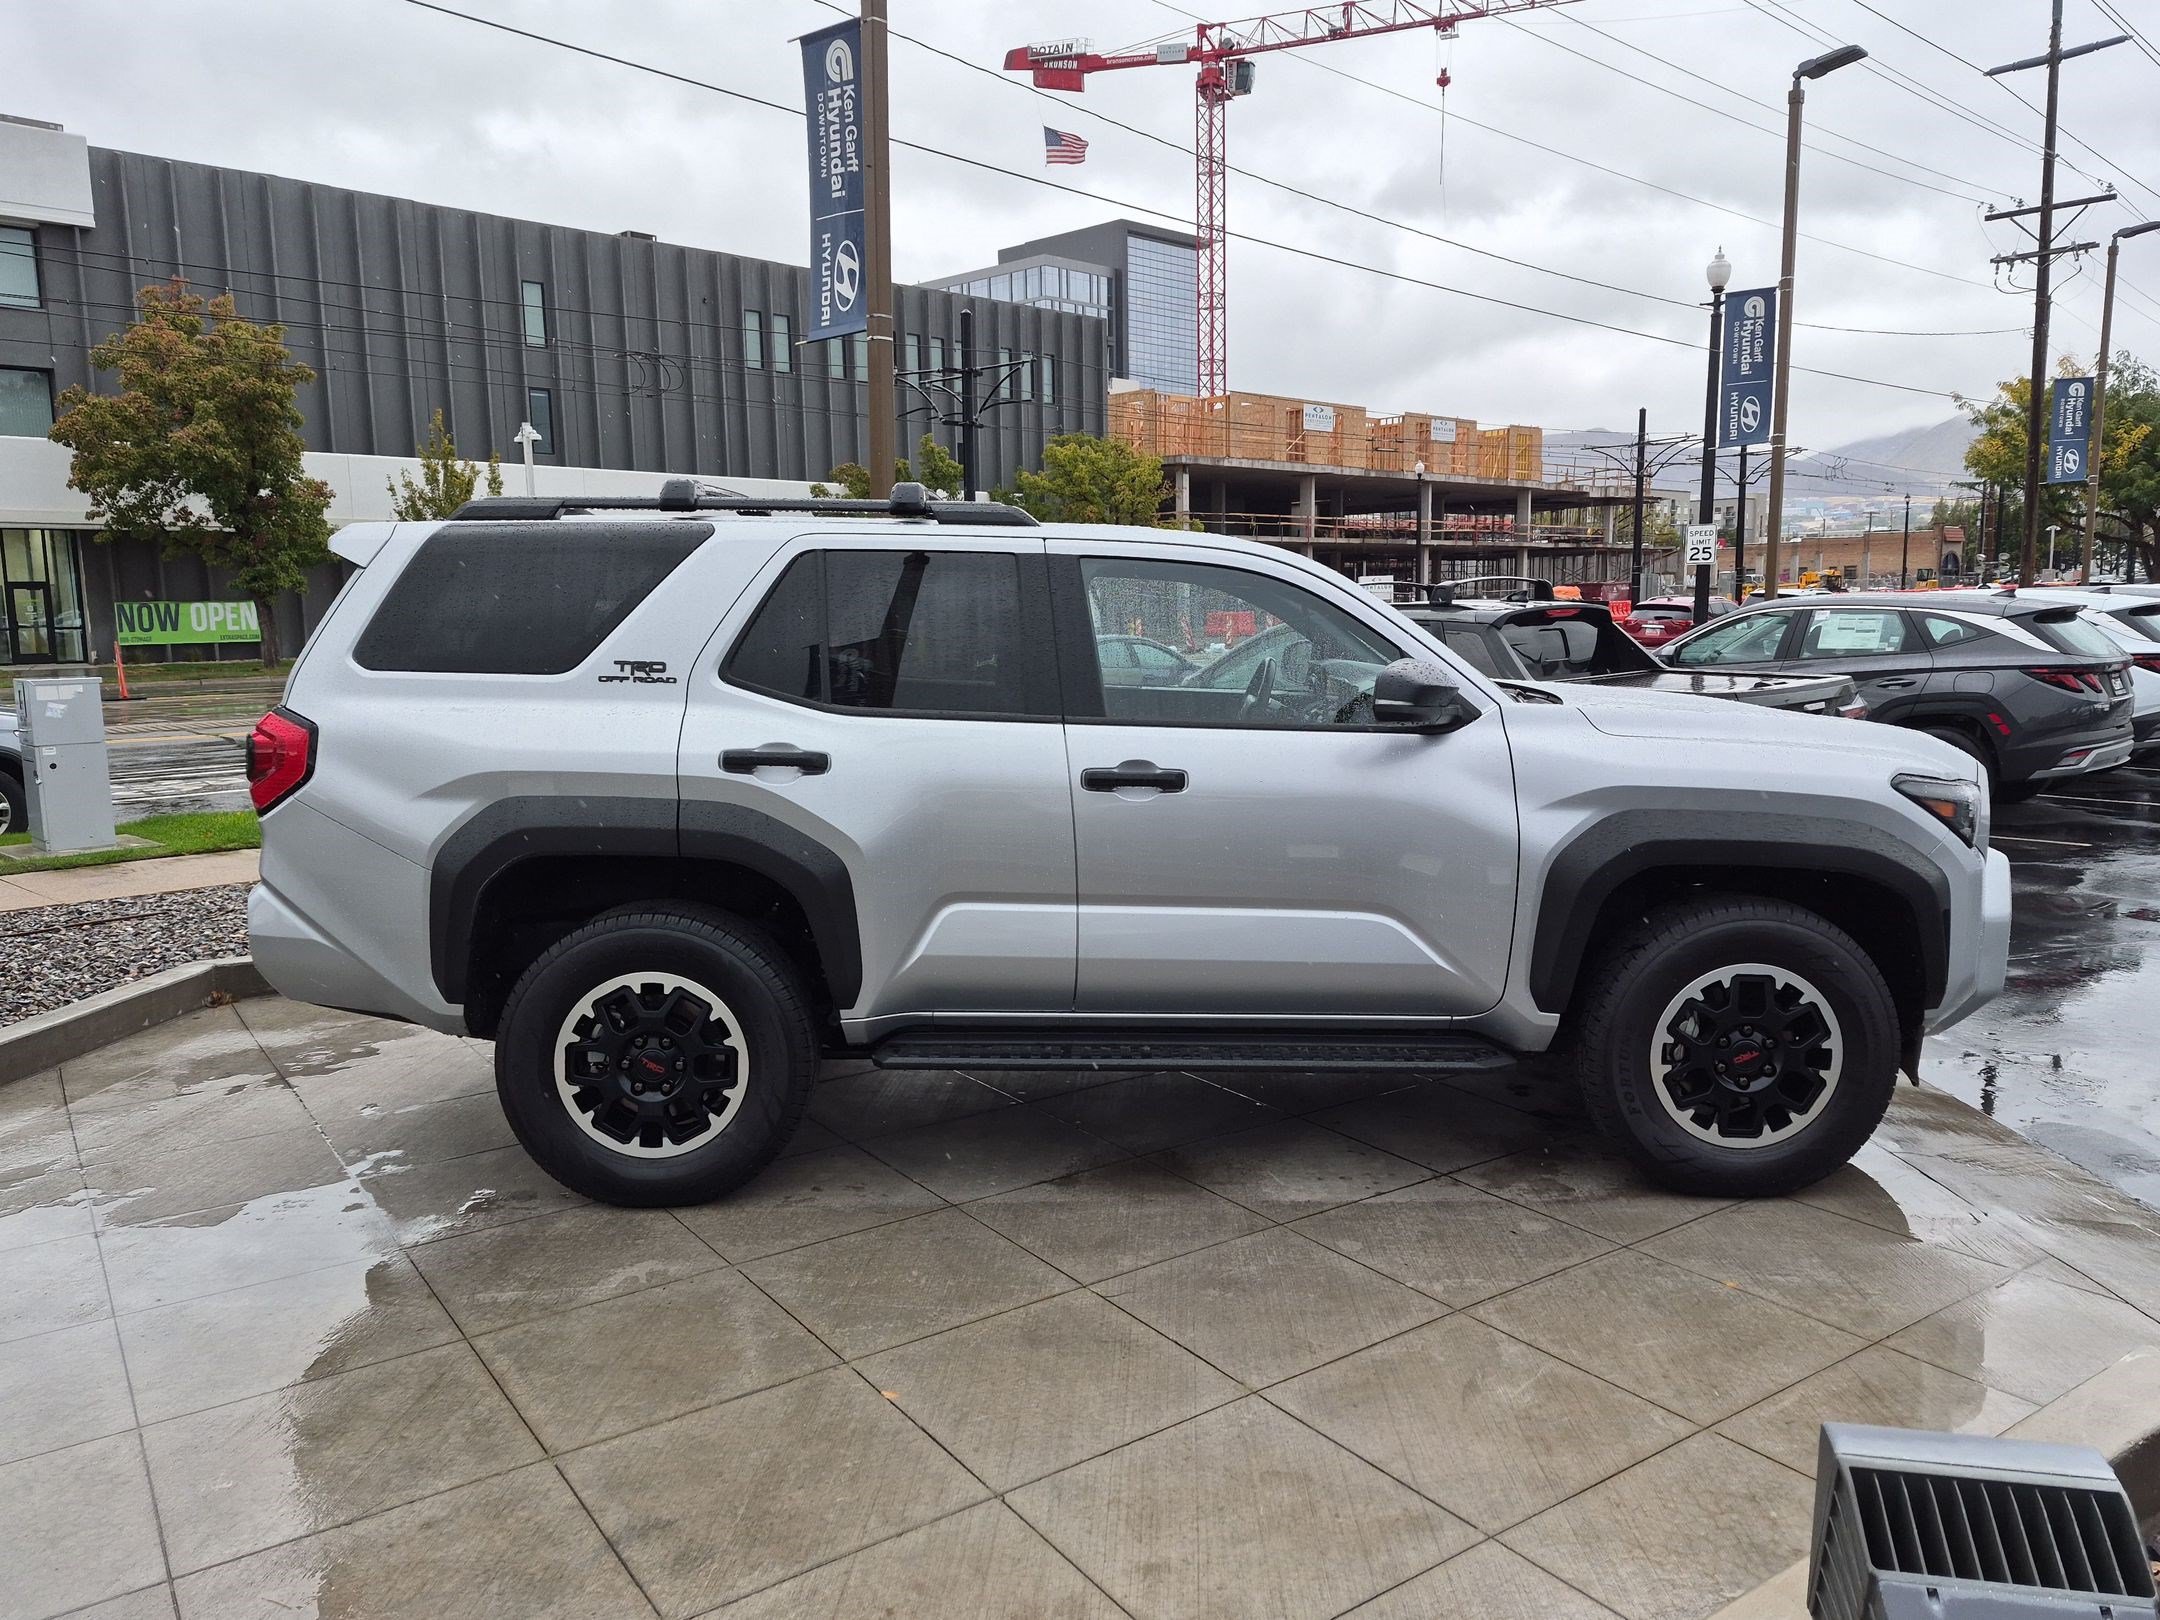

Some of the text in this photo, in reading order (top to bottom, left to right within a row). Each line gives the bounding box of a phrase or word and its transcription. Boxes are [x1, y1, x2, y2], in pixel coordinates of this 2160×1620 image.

[817, 92, 827, 178] DOWNTOWN
[826, 87, 846, 199] Hyundai
[842, 84, 859, 173] Ken Garff
[821, 232, 831, 327] HYUNDAI
[1740, 320, 1754, 375] Hyundai
[1753, 318, 1765, 363] Ken Garff
[1729, 391, 1739, 440] HYUNDAI
[2064, 398, 2076, 435] Hyundai
[2076, 398, 2084, 411] Ken
[2055, 445, 2063, 479] HYUNDAI
[1689, 547, 1712, 561] 25
[116, 602, 259, 633] NOW OPEN
[613, 660, 667, 676] TRD
[641, 1057, 665, 1073] TRD
[1733, 1051, 1760, 1064] TRD
